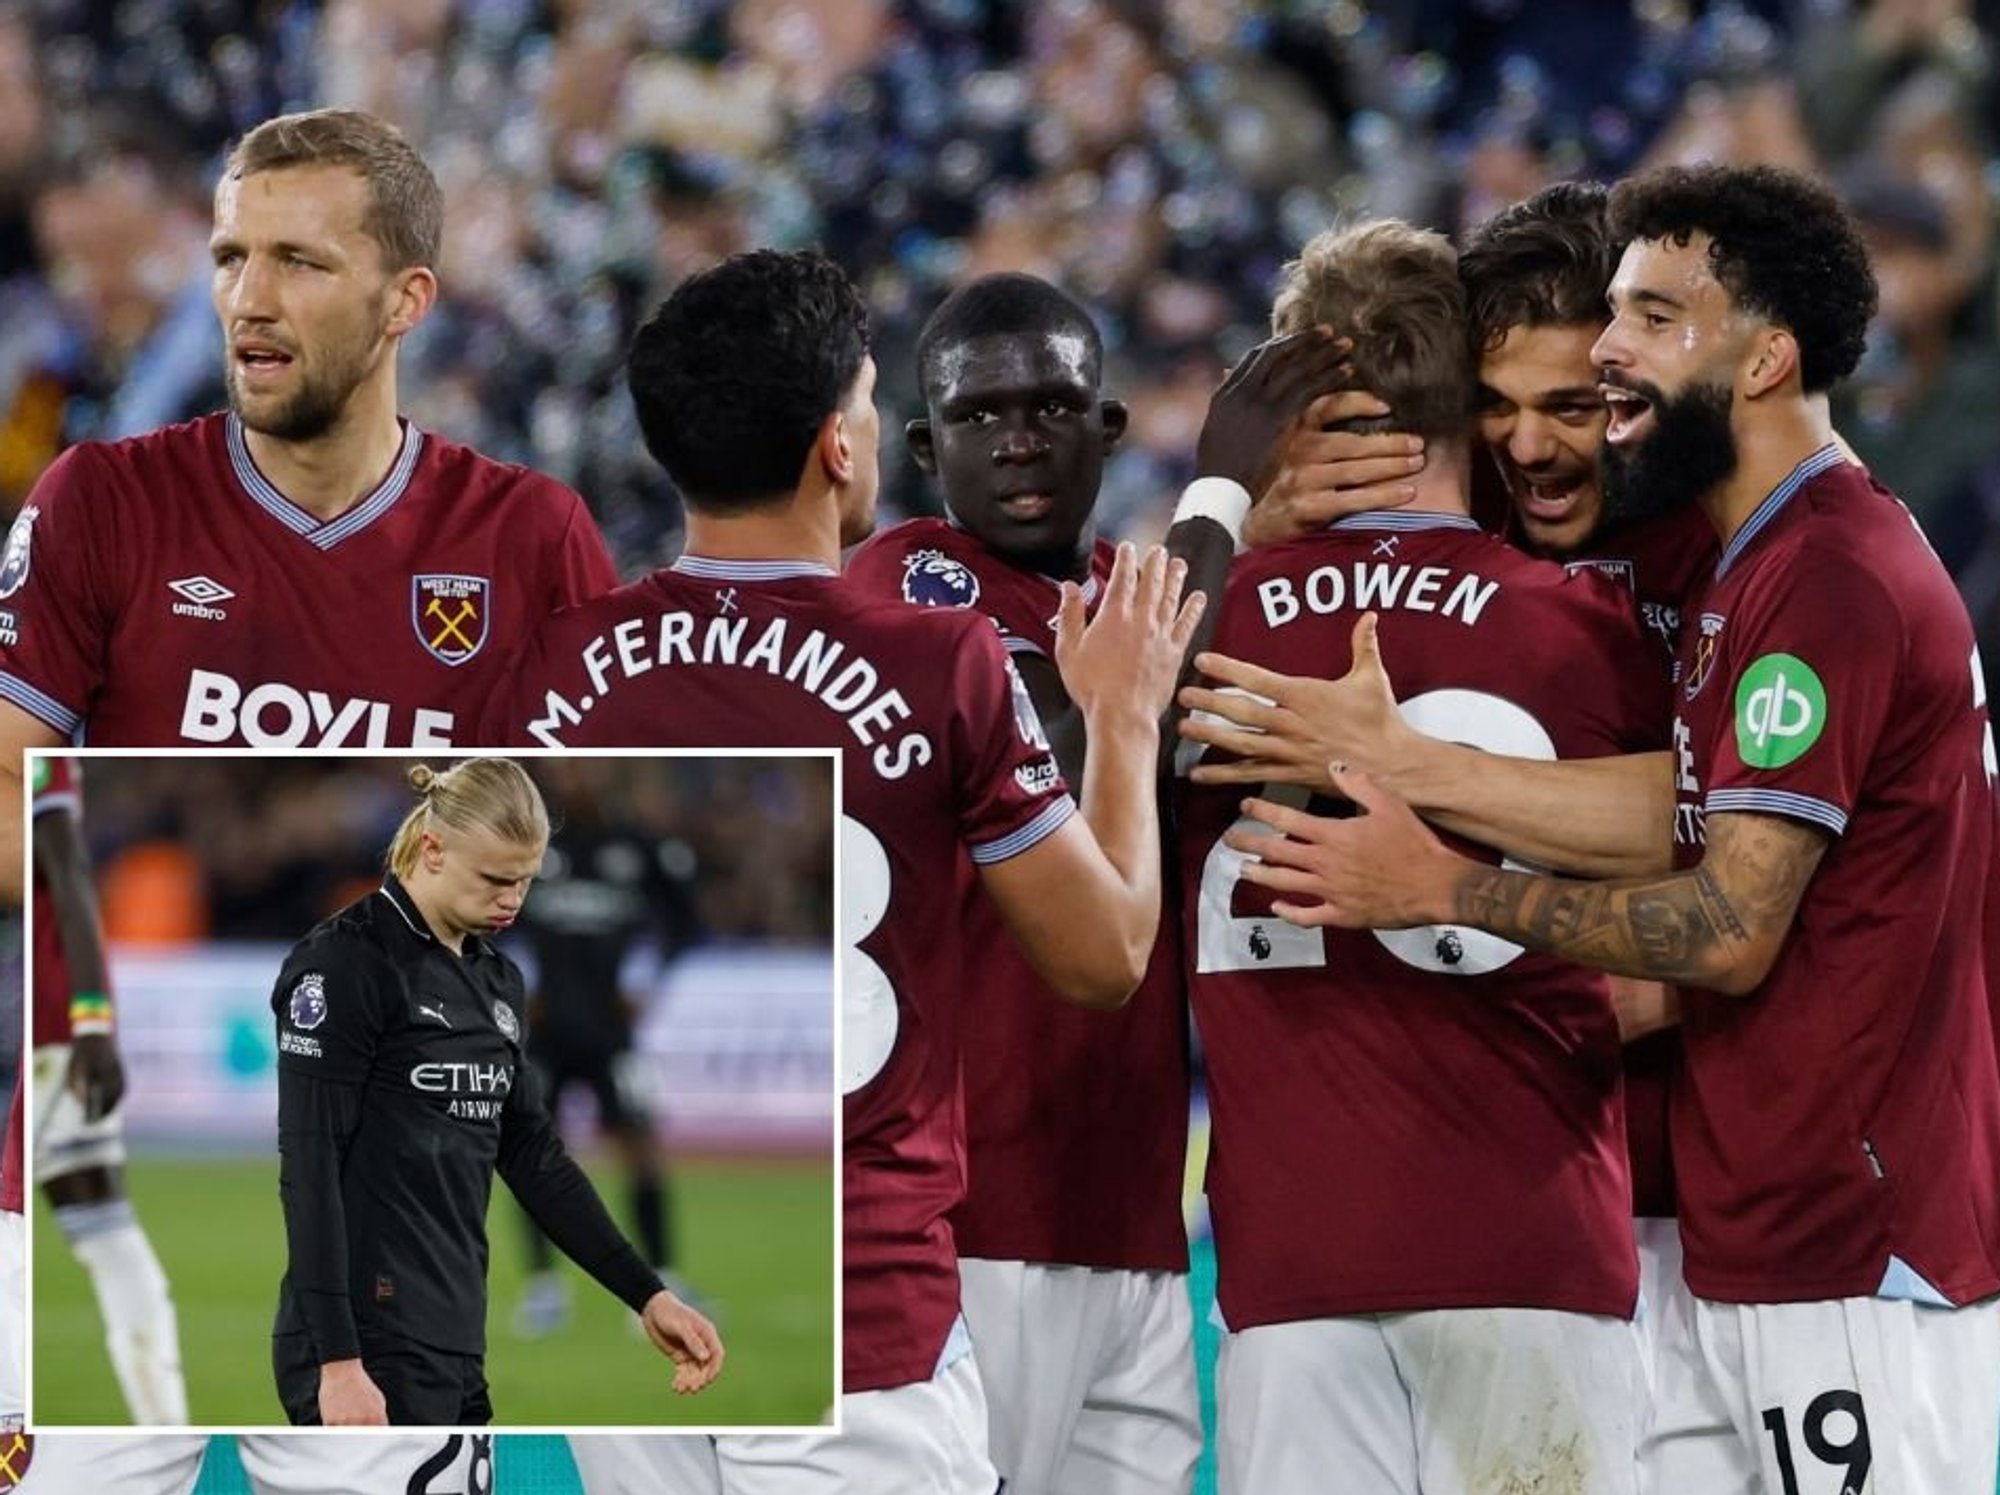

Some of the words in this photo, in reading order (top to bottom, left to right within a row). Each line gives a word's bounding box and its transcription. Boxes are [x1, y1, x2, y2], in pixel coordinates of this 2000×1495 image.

[421, 580, 451, 590] WEST
[453, 580, 481, 592] HAM
[1256, 562, 1499, 628] BOWEN
[173, 602, 227, 620] umbro
[527, 611, 931, 780] M.FERNANDES
[410, 1063, 515, 1093] ETIHA
[1762, 1389, 1873, 1495] 19
